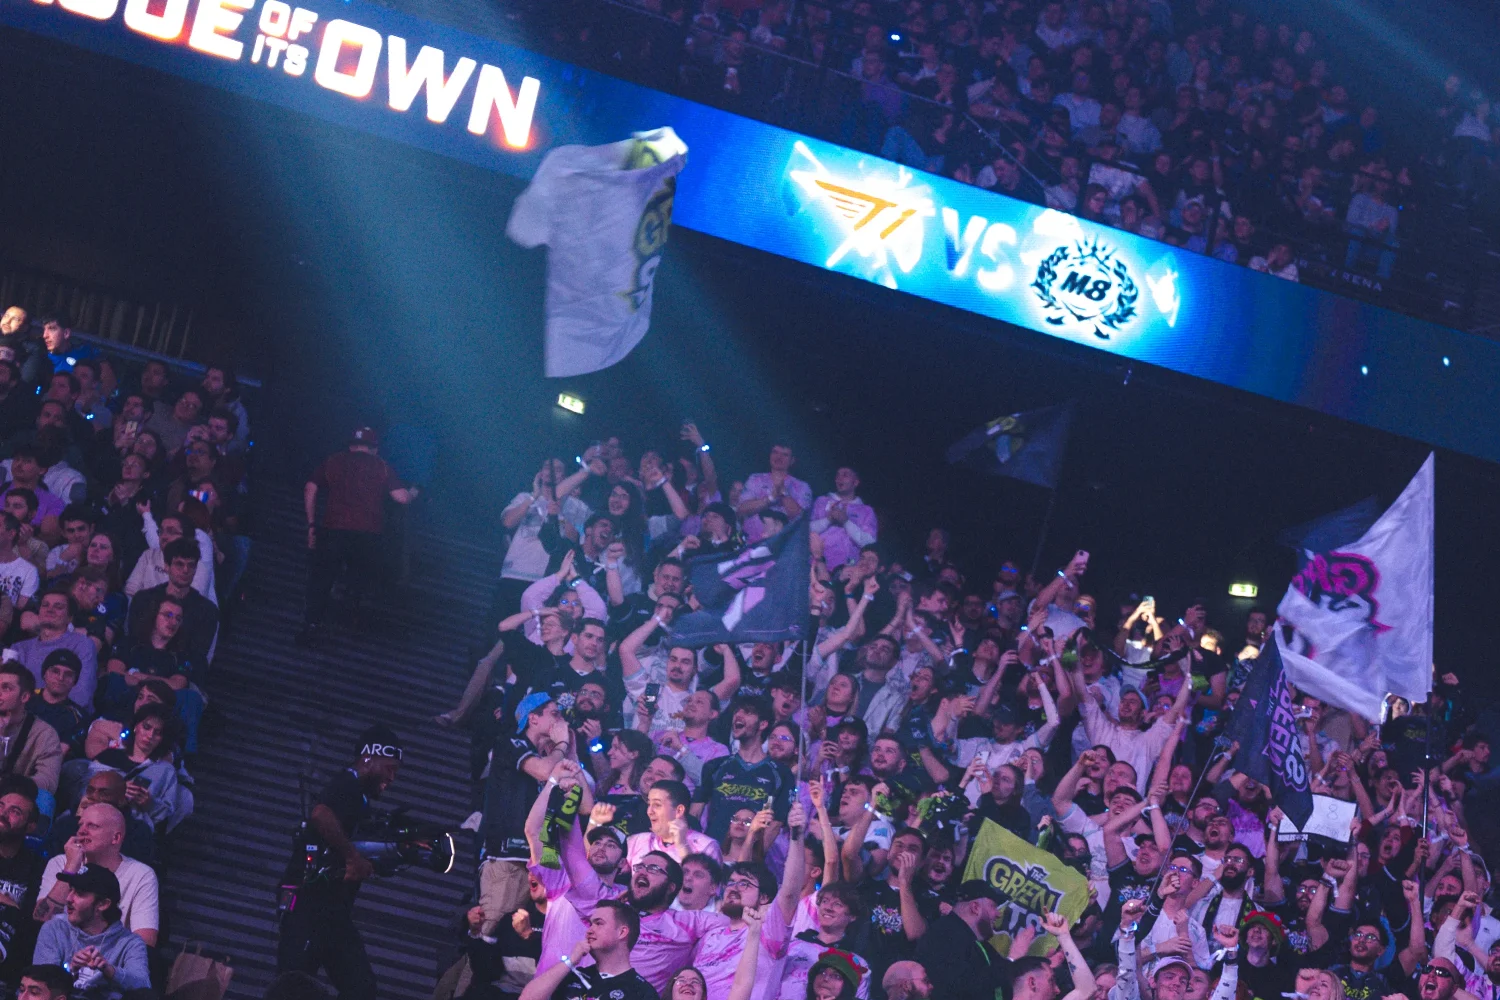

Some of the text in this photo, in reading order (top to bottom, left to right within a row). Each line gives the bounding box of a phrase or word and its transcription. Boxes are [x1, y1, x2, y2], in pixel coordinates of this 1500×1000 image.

[250, 34, 307, 77] ITS
[258, 1, 318, 41] OF
[314, 18, 540, 149] OWN
[940, 206, 1018, 293] VS
[1059, 270, 1111, 303] M8
[990, 862, 1056, 912] GREEN
[1029, 867, 1044, 881] THE
